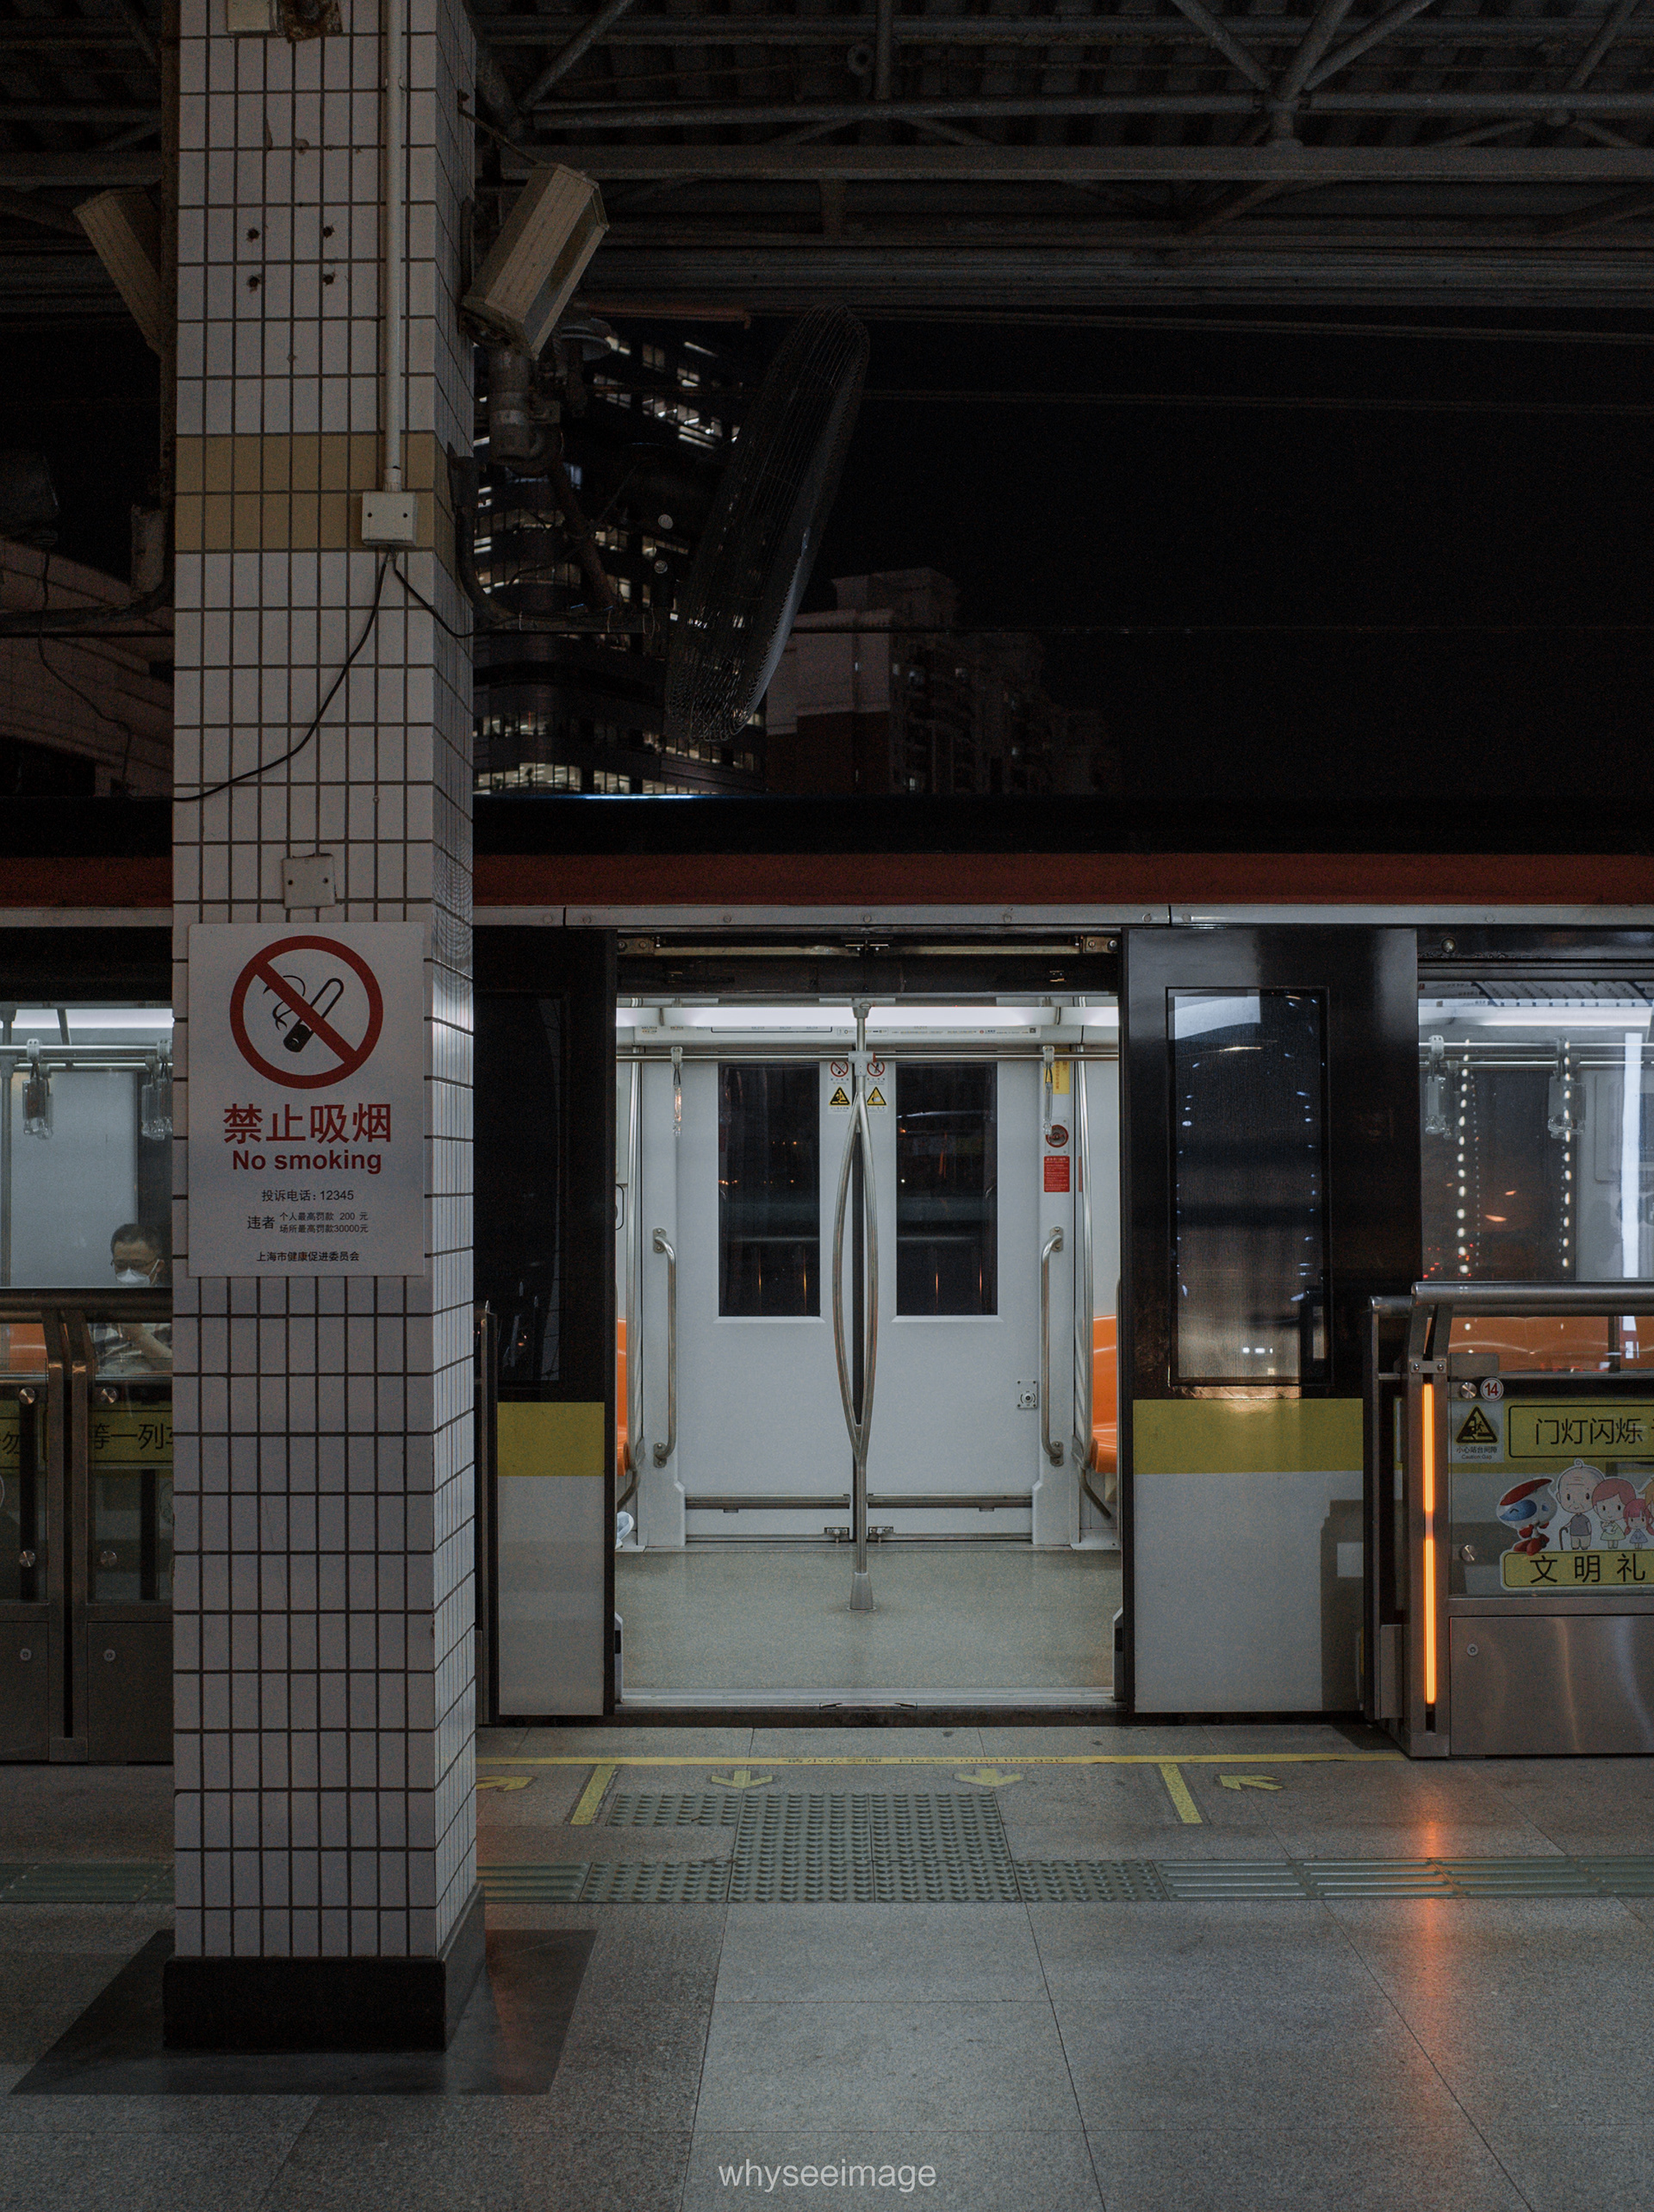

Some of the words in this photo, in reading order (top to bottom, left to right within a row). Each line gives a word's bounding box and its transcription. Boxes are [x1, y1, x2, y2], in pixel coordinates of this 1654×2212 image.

[223, 1103, 391, 1144] 禁止吸烟
[233, 1150, 266, 1170] No
[274, 1149, 382, 1175] smoking
[247, 1215, 276, 1230] 违者
[280, 1212, 334, 1221] 个人最高罚款
[339, 1212, 355, 1221] 200
[359, 1212, 369, 1221] 元
[257, 1251, 360, 1262] 上海市健康促进委员会
[1484, 1382, 1499, 1396] 14
[90, 1423, 172, 1450] 等一列
[1530, 1553, 1645, 1583] 文明礼
